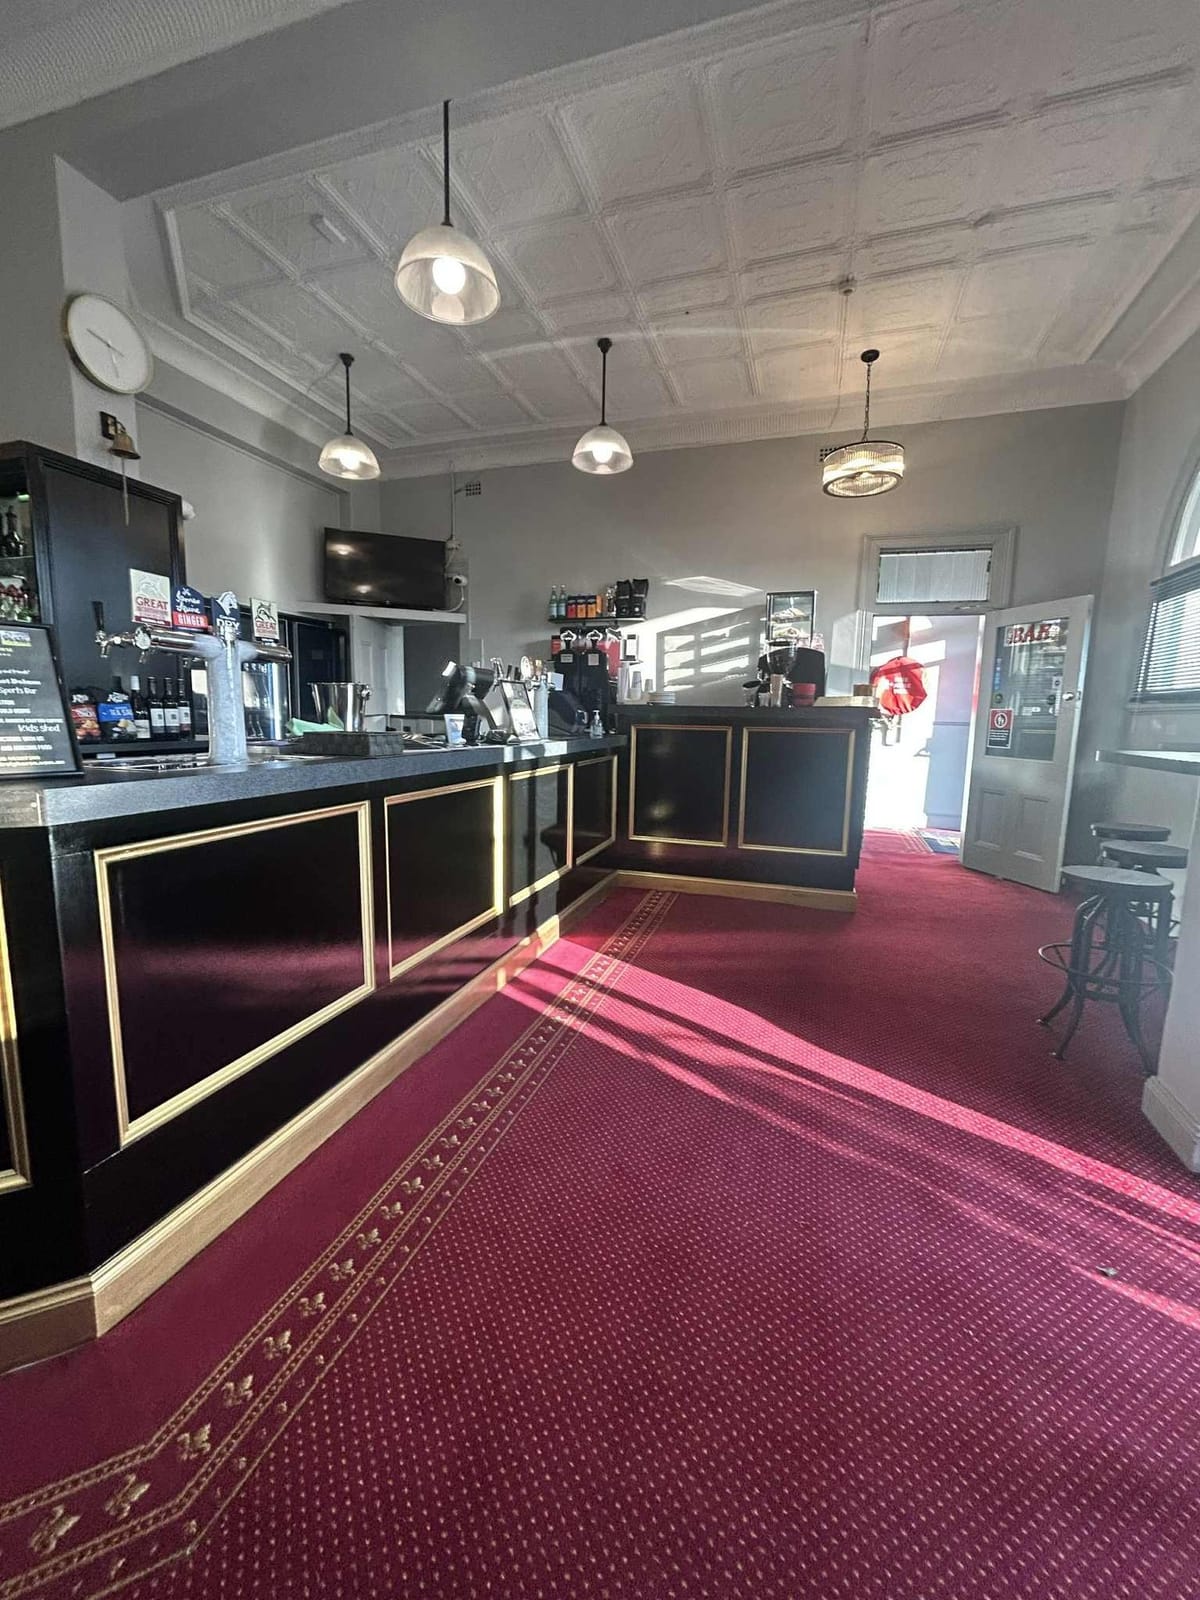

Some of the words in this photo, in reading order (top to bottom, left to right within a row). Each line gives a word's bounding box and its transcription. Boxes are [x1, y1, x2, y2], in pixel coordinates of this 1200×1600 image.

[136, 596, 168, 611] GREAT
[178, 613, 206, 627] GINGER
[256, 620, 277, 631] GREAT
[1008, 623, 1050, 644] BAR
